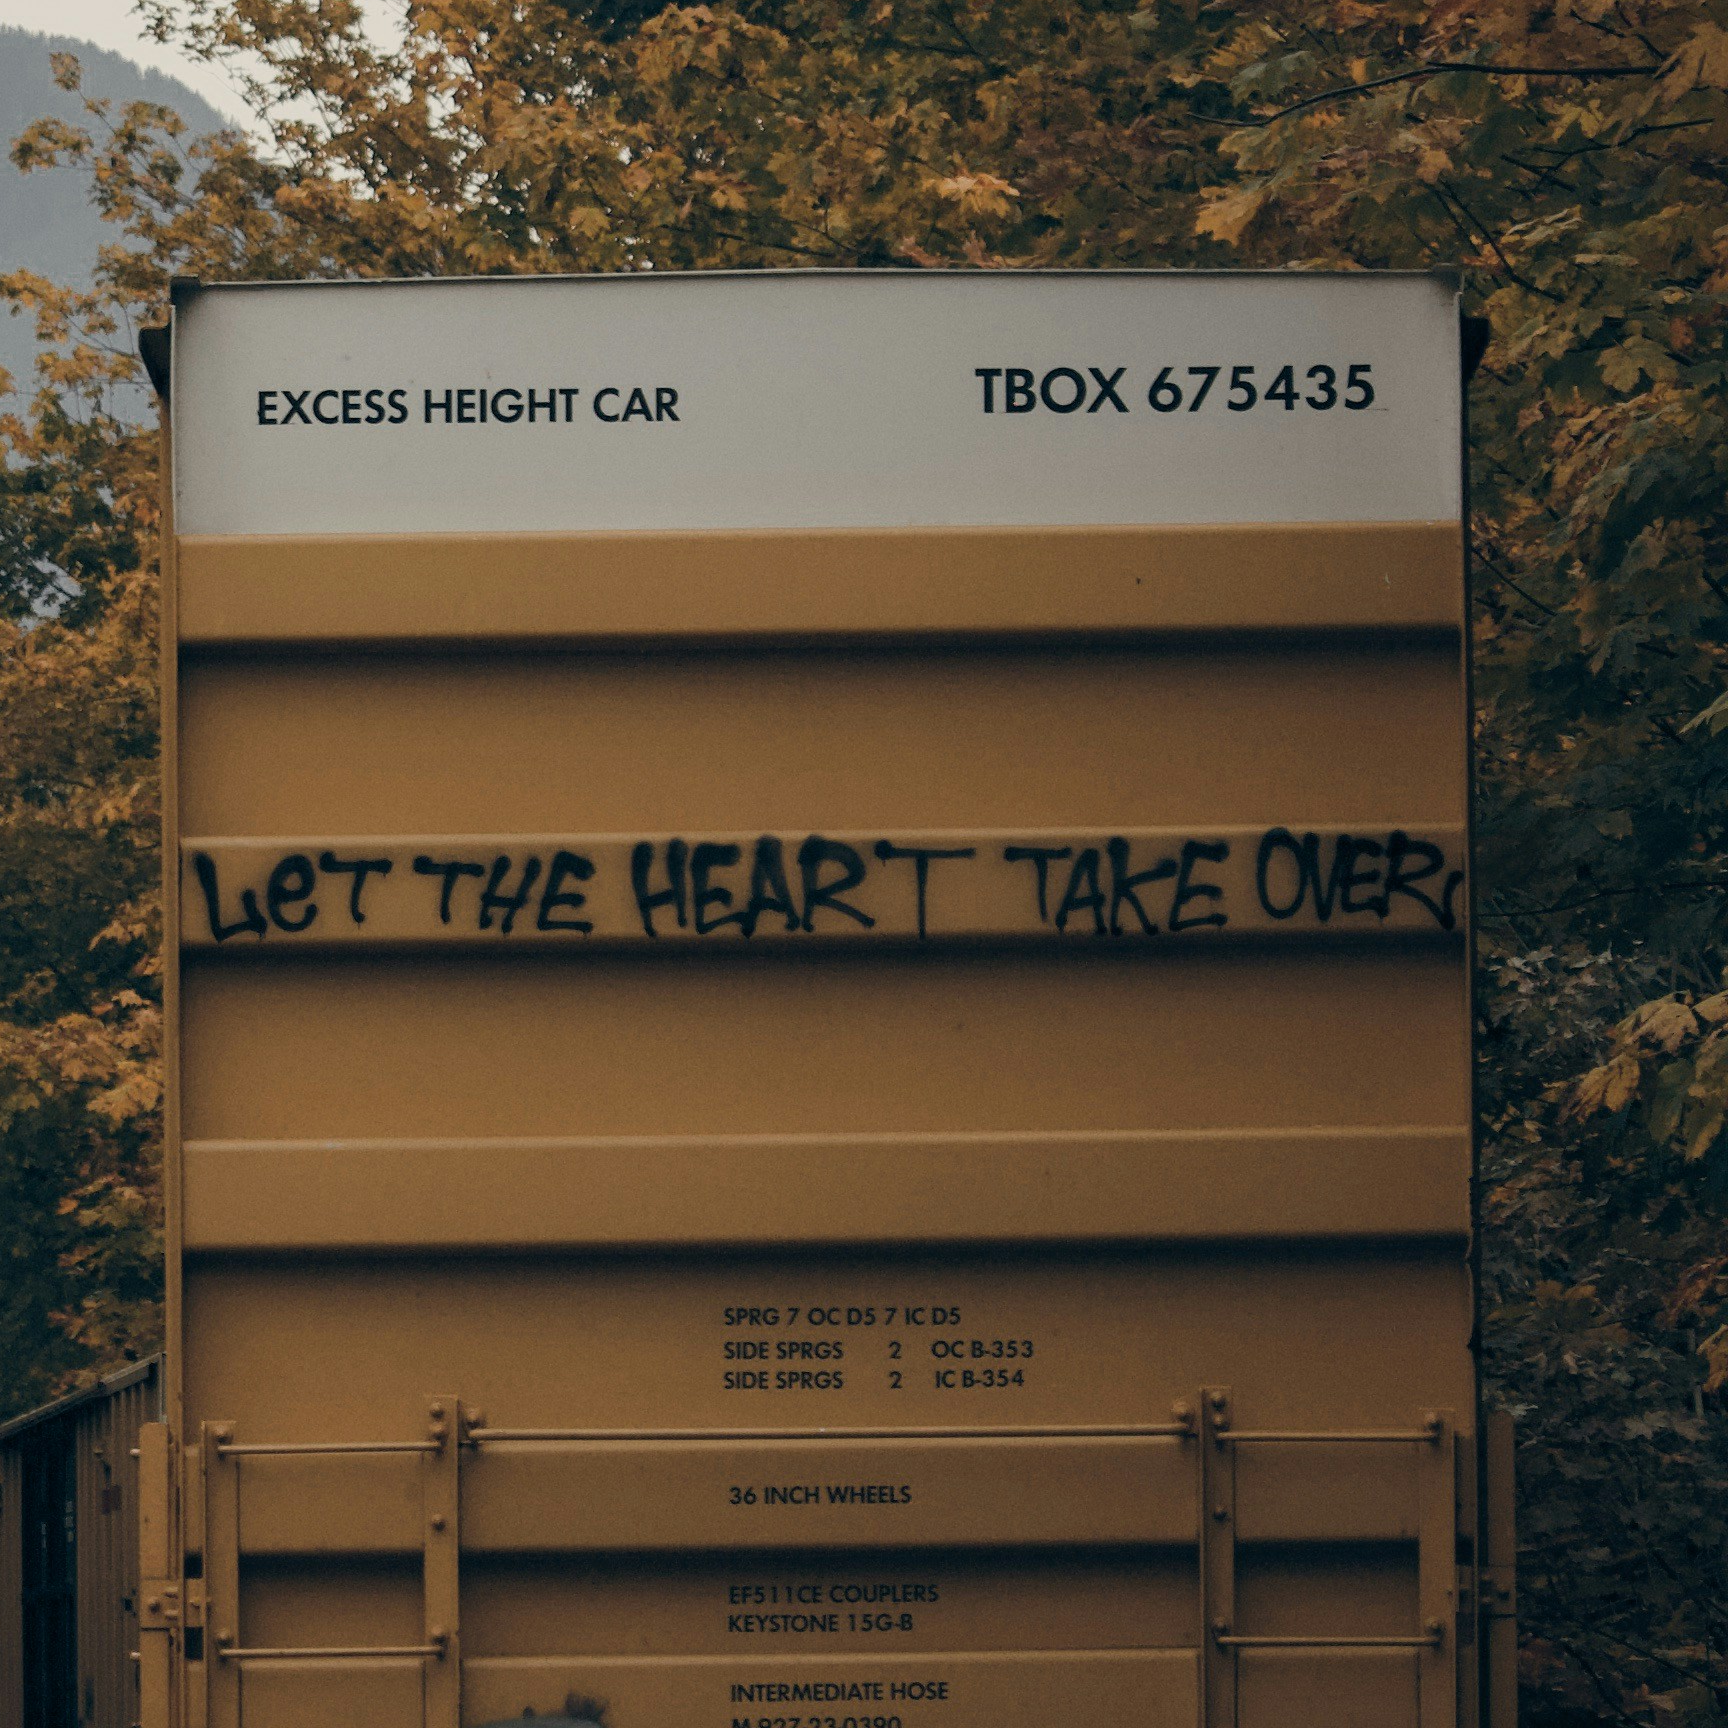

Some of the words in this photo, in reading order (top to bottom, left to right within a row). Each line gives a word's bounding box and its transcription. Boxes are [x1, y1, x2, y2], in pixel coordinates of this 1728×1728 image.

[974, 366, 1129, 414] TBOX
[1147, 363, 1375, 413] 675435
[257, 388, 409, 426] EXCESS
[424, 388, 579, 424] HEIGHT
[592, 387, 680, 423] CAR
[412, 849, 595, 935] THE
[631, 833, 976, 940] HEART
[1003, 836, 1229, 937] TAKE
[724, 1306, 780, 1326] SPRG
[787, 1306, 801, 1325] 7
[807, 1306, 841, 1326] OC
[846, 1306, 877, 1326] D5
[884, 1306, 898, 1325] 7
[904, 1306, 926, 1326] IC
[931, 1306, 961, 1326] D5
[723, 1341, 769, 1360] SIDE
[776, 1340, 844, 1360] SPRGS
[888, 1340, 902, 1360] 2
[930, 1339, 965, 1359] OC
[970, 1339, 1034, 1359] B-353
[723, 1370, 769, 1390] SIDE
[775, 1370, 844, 1390] SPRGS
[888, 1370, 902, 1389] 2
[935, 1369, 956, 1389] IC
[961, 1368, 1025, 1389] B-354
[729, 1486, 757, 1505] 36
[764, 1485, 820, 1505] INCH
[826, 1485, 912, 1504] WHEELS
[829, 1584, 940, 1603] COUPLERS
[728, 1613, 839, 1633] KEYSTONE
[731, 1682, 884, 1703] INTERMEDIATE
[890, 1681, 950, 1701] HOSE
